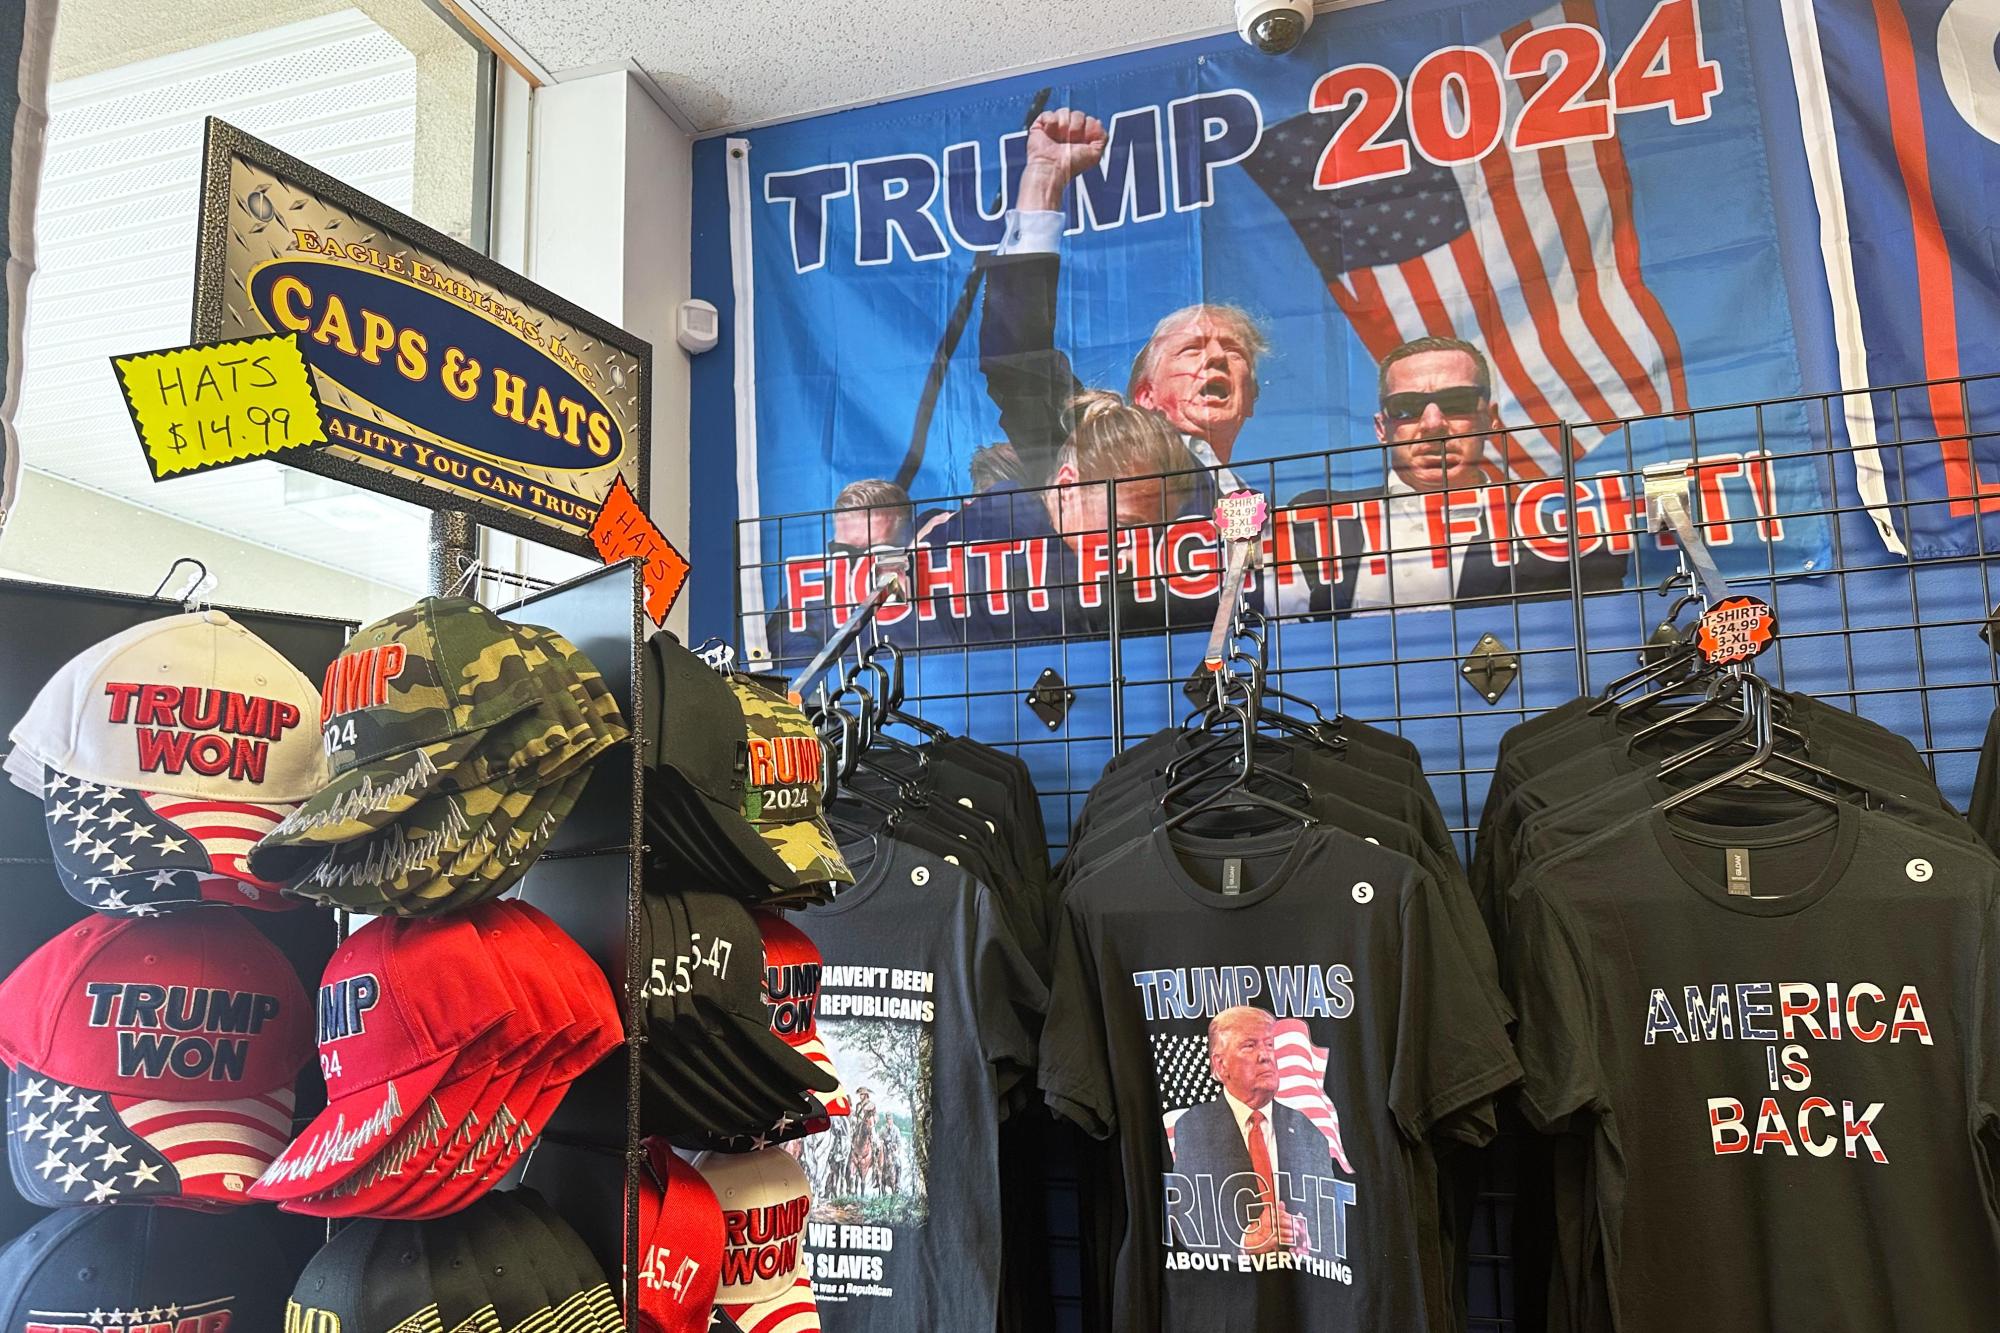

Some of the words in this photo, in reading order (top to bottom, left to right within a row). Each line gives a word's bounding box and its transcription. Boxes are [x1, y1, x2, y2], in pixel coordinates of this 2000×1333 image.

[764, 89, 1262, 273] TRUMP
[1310, 0, 1723, 190] 2024
[292, 229, 407, 275] EAGLE
[410, 260, 545, 346] EMBLEMS,
[549, 336, 598, 388] INC.
[157, 356, 277, 406] HATS
[271, 275, 428, 382] CAPS
[440, 347, 483, 402] &
[492, 367, 612, 457] HATS
[167, 406, 290, 455] $14.99
[328, 418, 410, 458] ALITY
[405, 442, 467, 479] YOU
[472, 467, 523, 500] CAN
[529, 486, 597, 523] TRUST
[1220, 495, 1264, 508] T-SHIRTS
[1223, 507, 1257, 518] $24.99
[1230, 519, 1252, 527] 3-XL
[615, 511, 671, 581] HATS
[1223, 526, 1257, 539] $29.99
[1702, 605, 1768, 626] T-SHIRTS
[1711, 618, 1759, 638] $24.99
[1719, 633, 1749, 647] 3-XL
[1711, 642, 1757, 662] $29.99
[104, 681, 301, 741] TRUMP
[136, 726, 270, 783] WON
[748, 737, 821, 786] RUMP
[763, 787, 809, 810] 2024
[1358, 886, 1367, 898] S
[1914, 863, 1926, 877] S
[820, 965, 889, 989] HAVEN'T
[891, 969, 934, 993] BEEN
[1133, 965, 1262, 1021] TRUMP
[1269, 964, 1356, 1019] WAS
[86, 981, 281, 1035] TRUMP
[820, 994, 935, 1023] REPUBLICANS
[1644, 982, 1934, 1045] AMERICA
[116, 1031, 249, 1082] WON
[1766, 1045, 1812, 1091] IS
[1707, 1097, 1889, 1164] BACK
[723, 1195, 810, 1247] RUMP
[808, 1222, 837, 1249] WE
[840, 1225, 893, 1252] FREED
[1161, 1171, 1357, 1259] RIGHT
[638, 1245, 700, 1304] 45-47
[721, 1236, 799, 1287] WON
[816, 1253, 883, 1281] SLAVES
[1165, 1252, 1231, 1273] ABOUT
[1238, 1253, 1353, 1286] EVERYTHING
[845, 1282, 893, 1298] Republican
